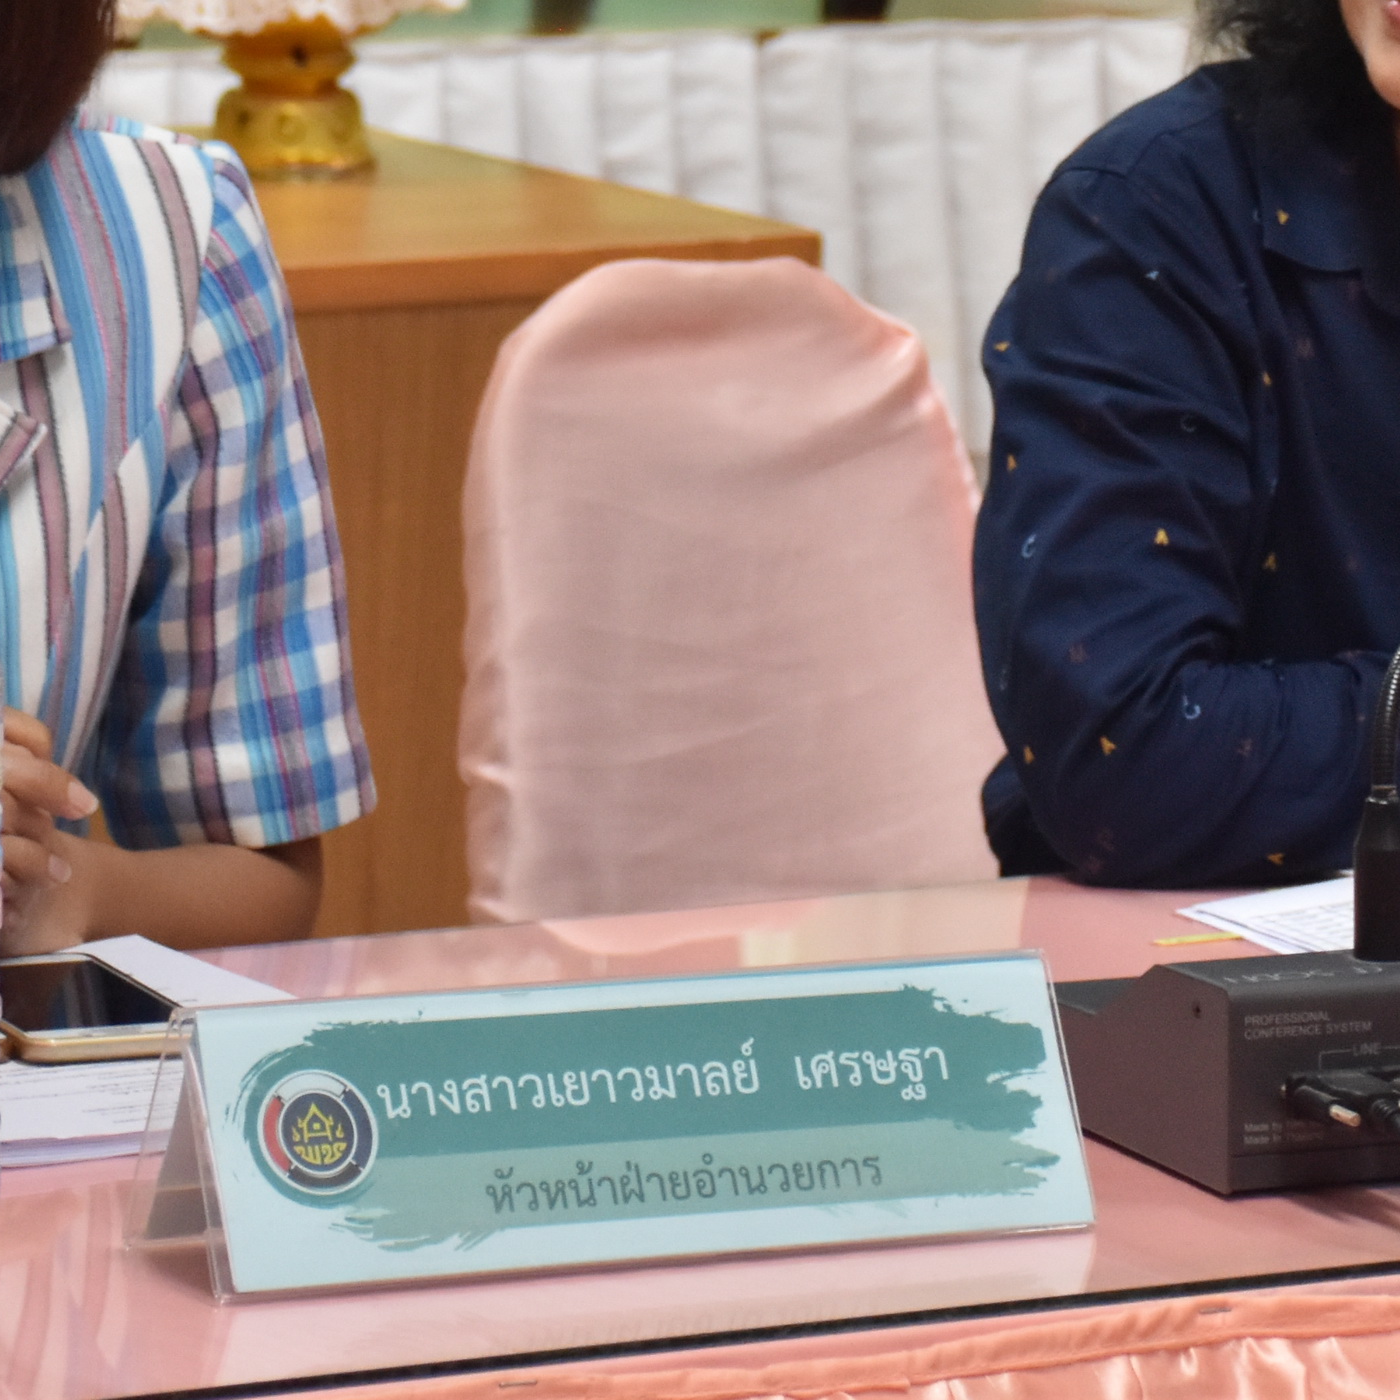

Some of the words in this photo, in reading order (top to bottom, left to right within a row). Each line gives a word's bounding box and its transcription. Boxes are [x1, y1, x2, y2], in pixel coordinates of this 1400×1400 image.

[1243, 1011, 1331, 1027] PROFESSIONAL
[1243, 1024, 1322, 1041] CONFERENCE
[1325, 1020, 1374, 1035] SYSTEM
[376, 1037, 761, 1120] นางสาวเยาวมาลย์
[794, 1046, 950, 1101] เศรษฐา
[485, 1152, 884, 1214] หัวหน้าฝ่ายอำนวยการ
